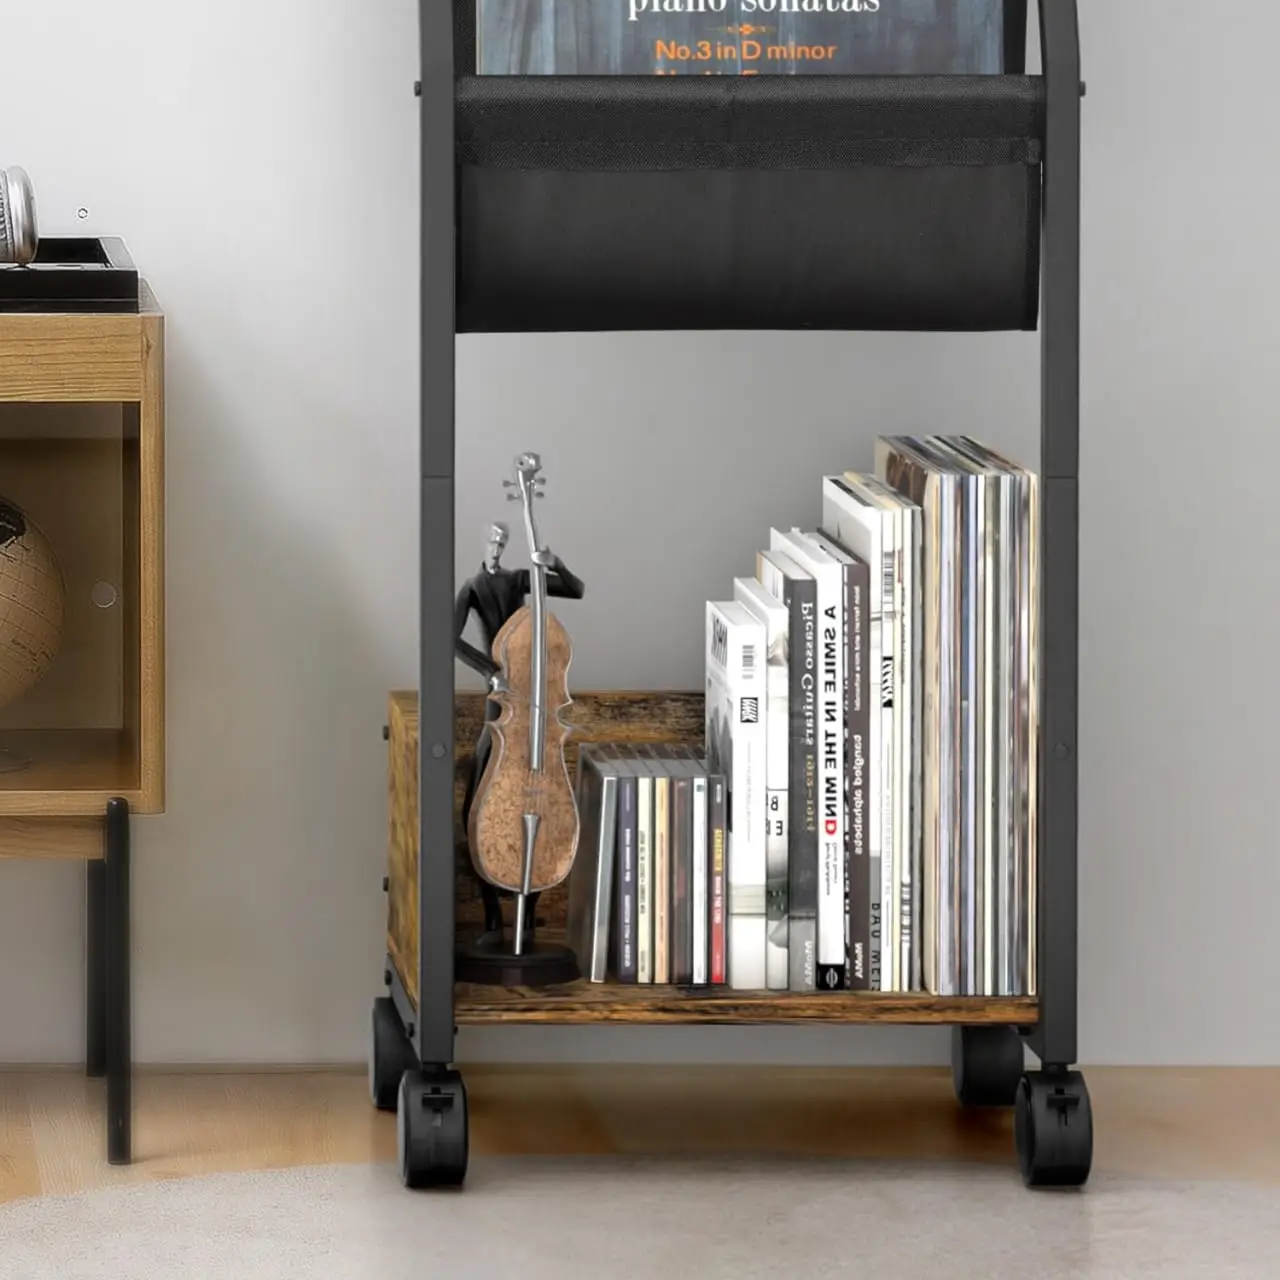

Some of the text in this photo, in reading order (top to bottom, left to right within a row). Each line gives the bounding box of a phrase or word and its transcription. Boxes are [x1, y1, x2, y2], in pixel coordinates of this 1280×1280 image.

[716, 41, 736, 60] in
[741, 40, 761, 60] D
[767, 41, 837, 60] minor
